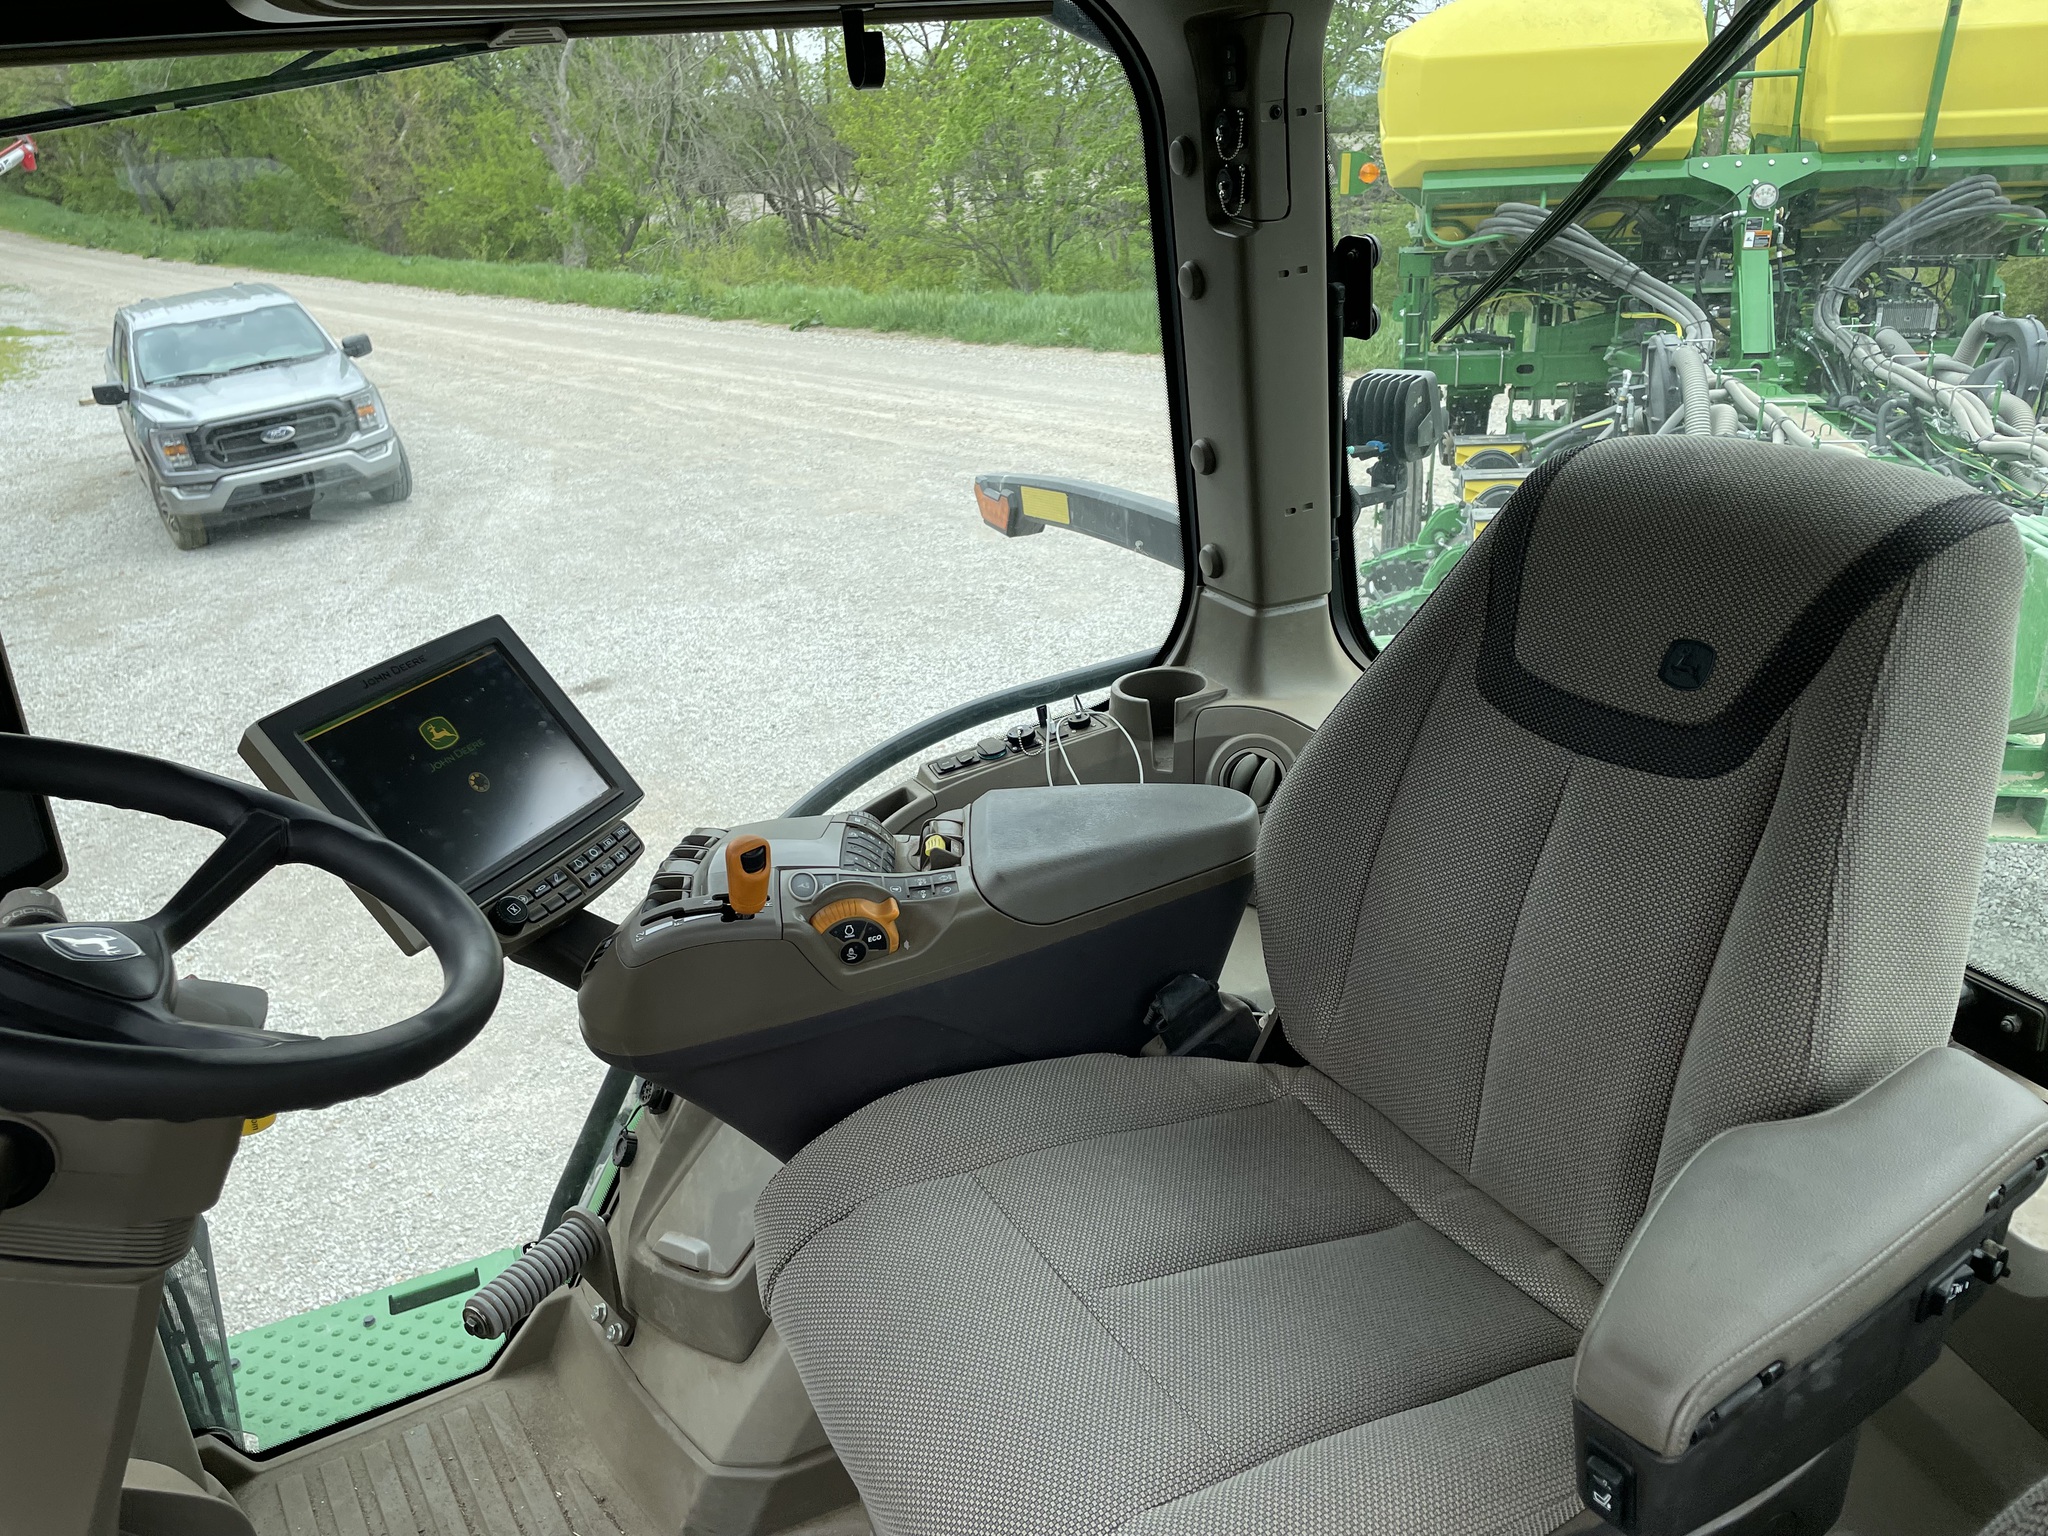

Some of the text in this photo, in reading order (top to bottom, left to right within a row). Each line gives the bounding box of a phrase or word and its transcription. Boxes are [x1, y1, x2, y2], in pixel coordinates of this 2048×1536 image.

[362, 655, 427, 689] JOHN DEERE
[429, 738, 486, 773] JOHN DEERE
[867, 934, 882, 943] ECO
